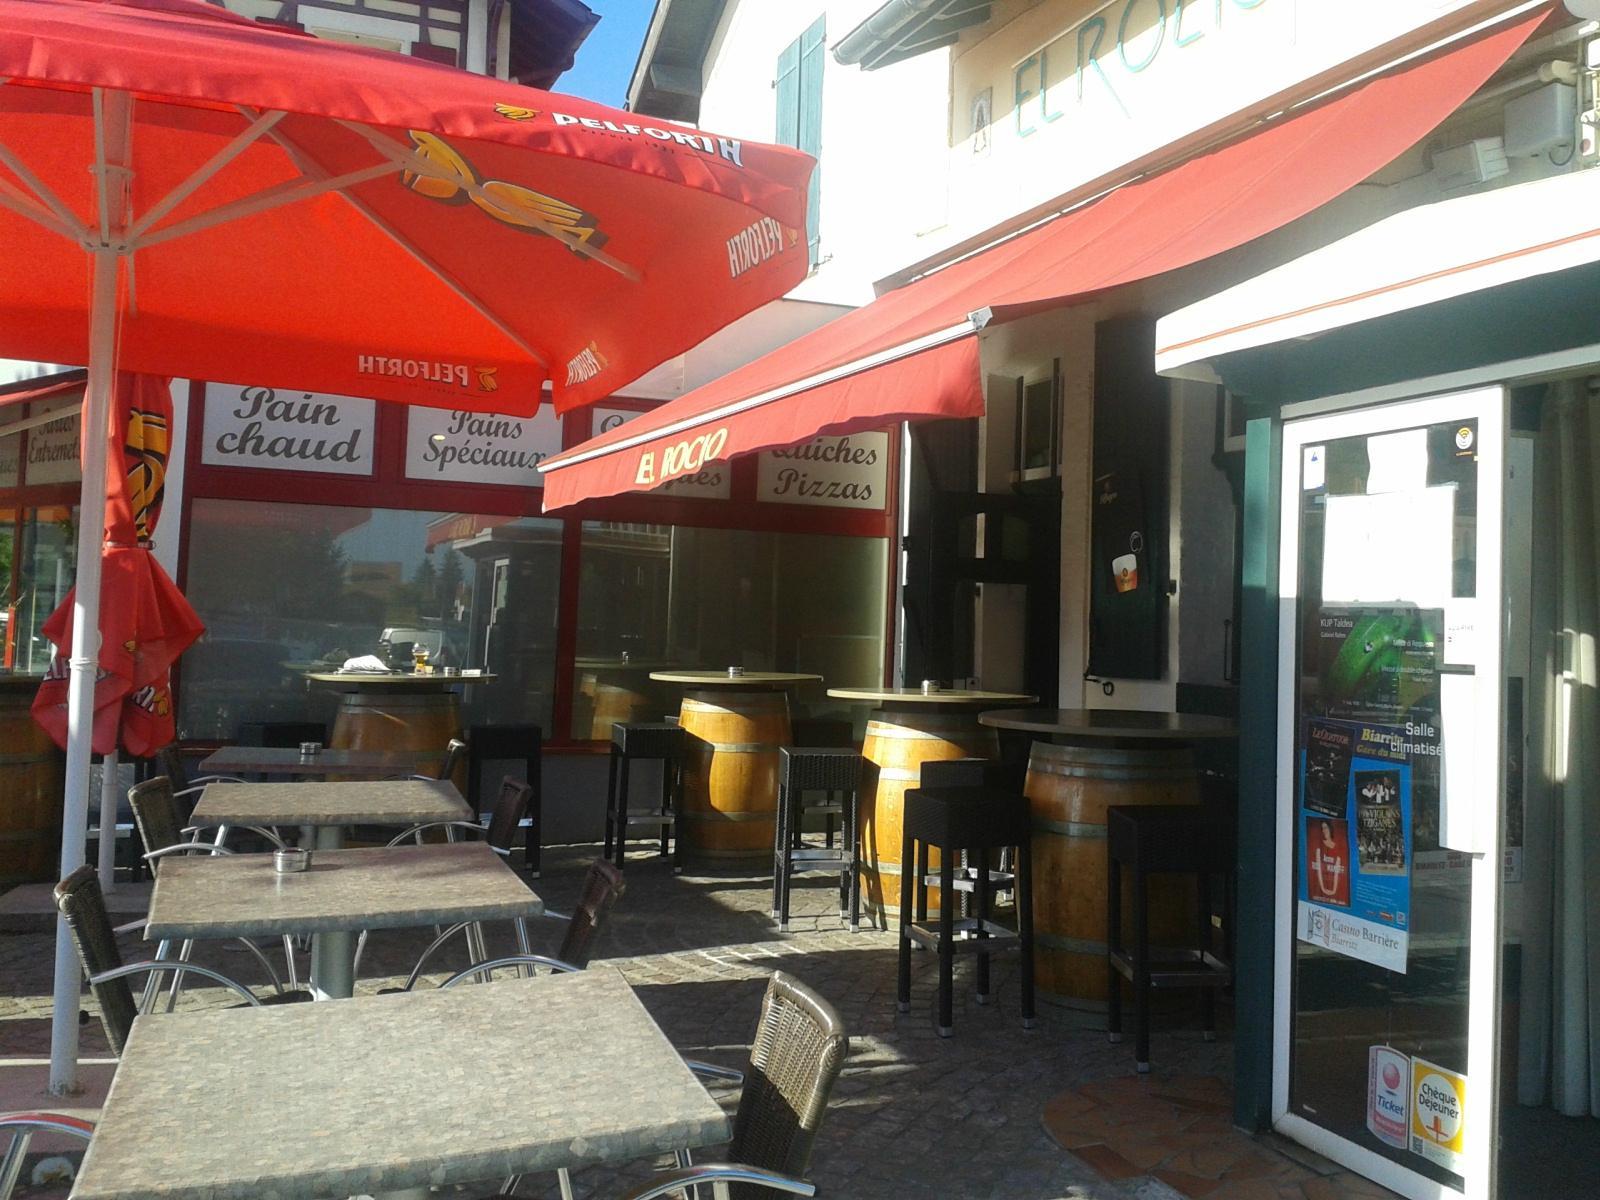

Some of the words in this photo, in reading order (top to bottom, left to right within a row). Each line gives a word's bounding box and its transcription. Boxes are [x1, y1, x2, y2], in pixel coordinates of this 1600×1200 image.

[1015, 48, 1065, 138] EL
[551, 112, 745, 168] PELFORTH
[233, 386, 341, 427] Pain
[215, 421, 361, 463] chaud
[447, 410, 523, 440] Pains
[422, 433, 547, 472] Spéciaux
[634, 451, 656, 485] EL
[660, 427, 729, 480] ROCIO
[773, 468, 873, 501] Pizzas
[1405, 721, 1435, 738] Salle
[1332, 918, 1361, 938] Casino
[1362, 927, 1399, 949] Barrière
[1377, 1094, 1405, 1117] Ticket
[1421, 1082, 1457, 1106] Chèque
